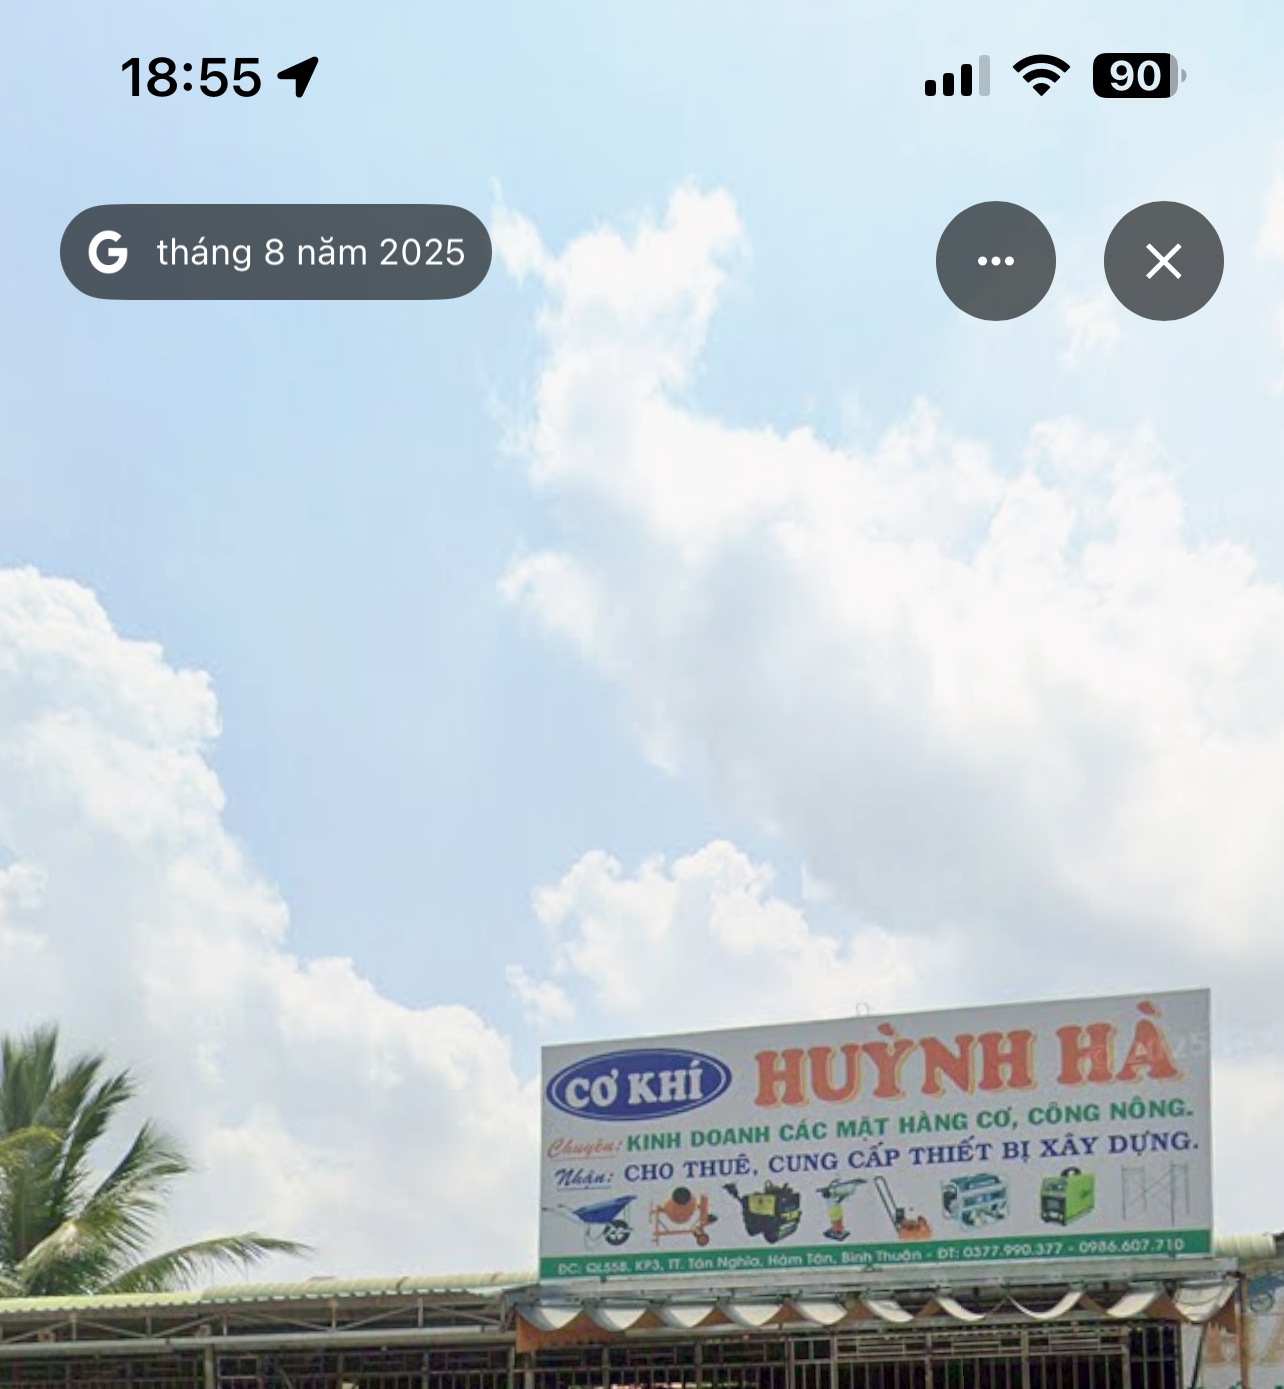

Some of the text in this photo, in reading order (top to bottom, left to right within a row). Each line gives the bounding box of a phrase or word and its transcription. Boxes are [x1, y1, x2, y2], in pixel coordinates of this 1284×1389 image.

[565, 1060, 703, 1109] CƠ KHÍ
[754, 1001, 1185, 1108] HUỲNH HÀ
[547, 1096, 1194, 1159] Chuyên: KINH DOANH CÁC MẶT HÀNG CƠ, CÔNG NÔNG.
[555, 1130, 1198, 1190] Nhận: CHO THUÊ, CUNG CẤP THIẾT BỊ XÂY DỰNG.
[688, 1256, 713, 1269] Tân
[876, 1249, 923, 1263] Thuận
[963, 1242, 1063, 1259] 0377.990.377
[1079, 1237, 1186, 1254] 0986.607.710
